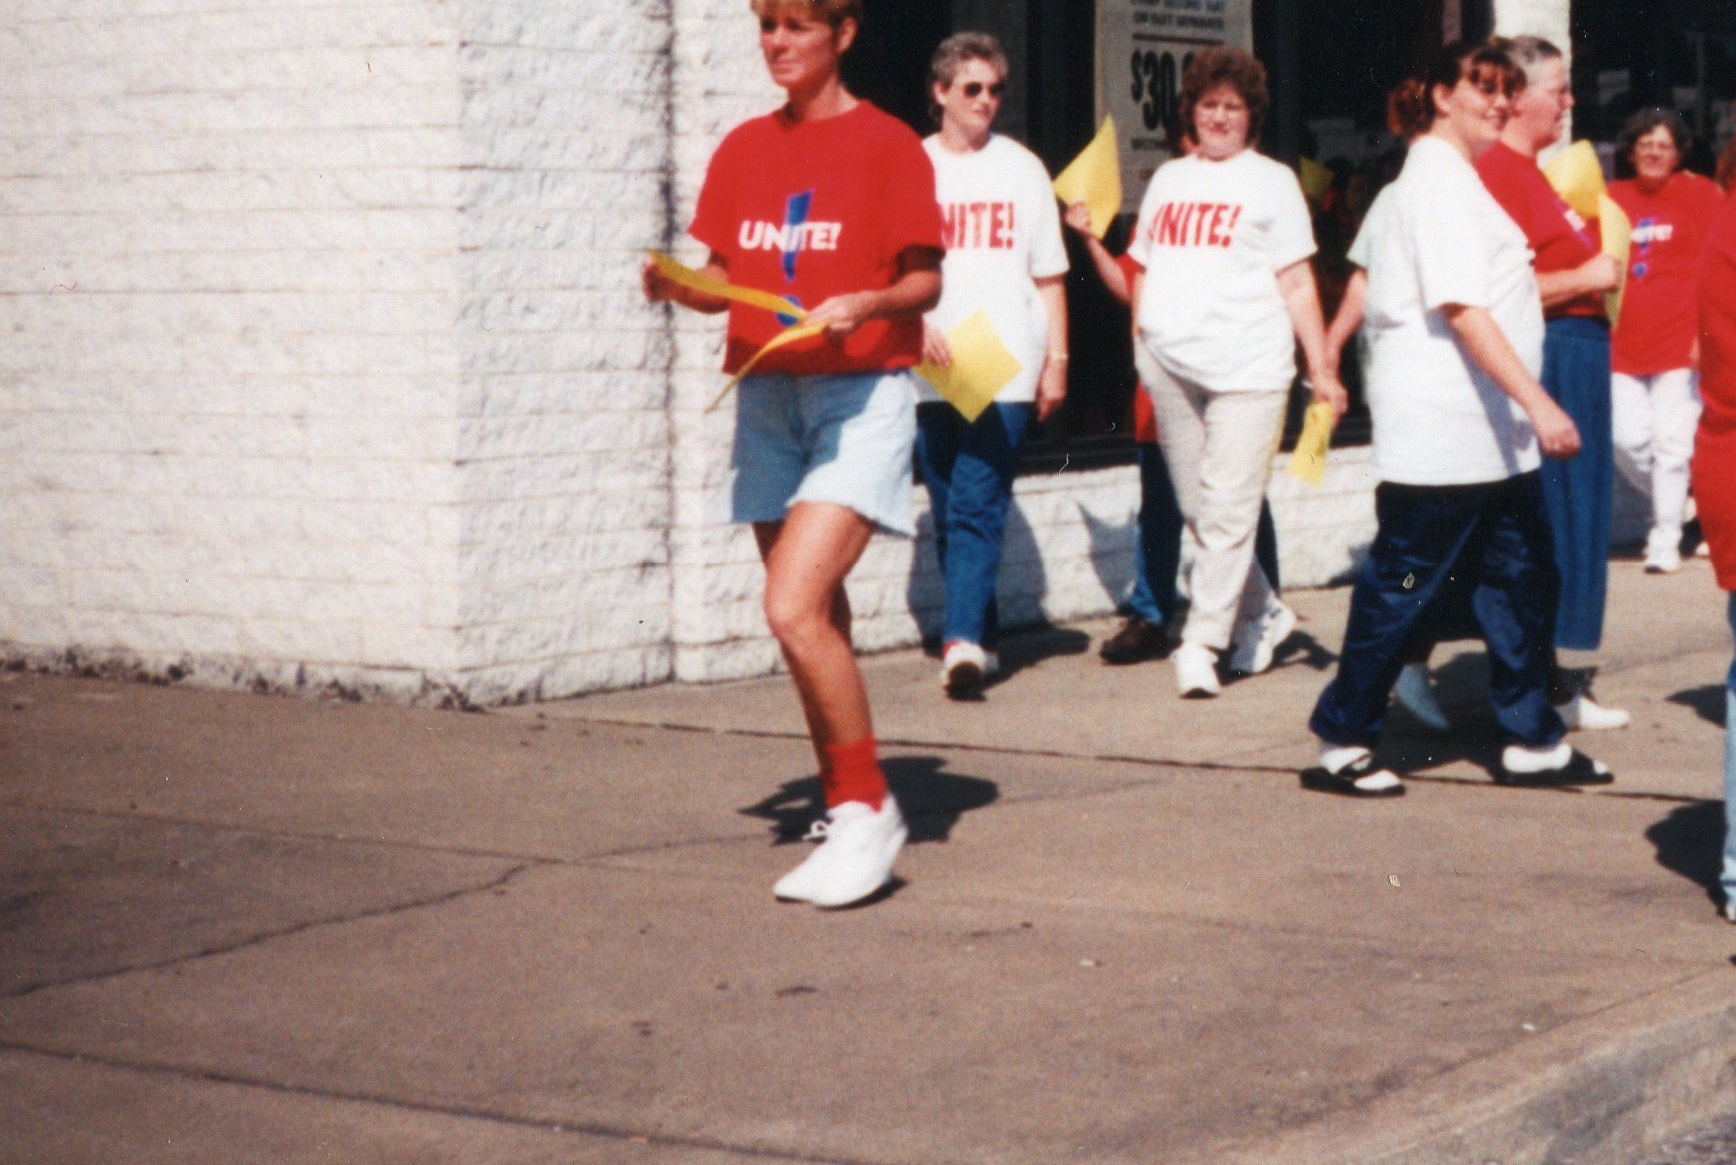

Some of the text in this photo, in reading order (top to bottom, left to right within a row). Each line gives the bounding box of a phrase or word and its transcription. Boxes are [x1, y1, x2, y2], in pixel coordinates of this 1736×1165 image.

[1131, 47, 1177, 132] $30
[738, 219, 843, 252] UNITE!
[940, 201, 1014, 249] NITE!
